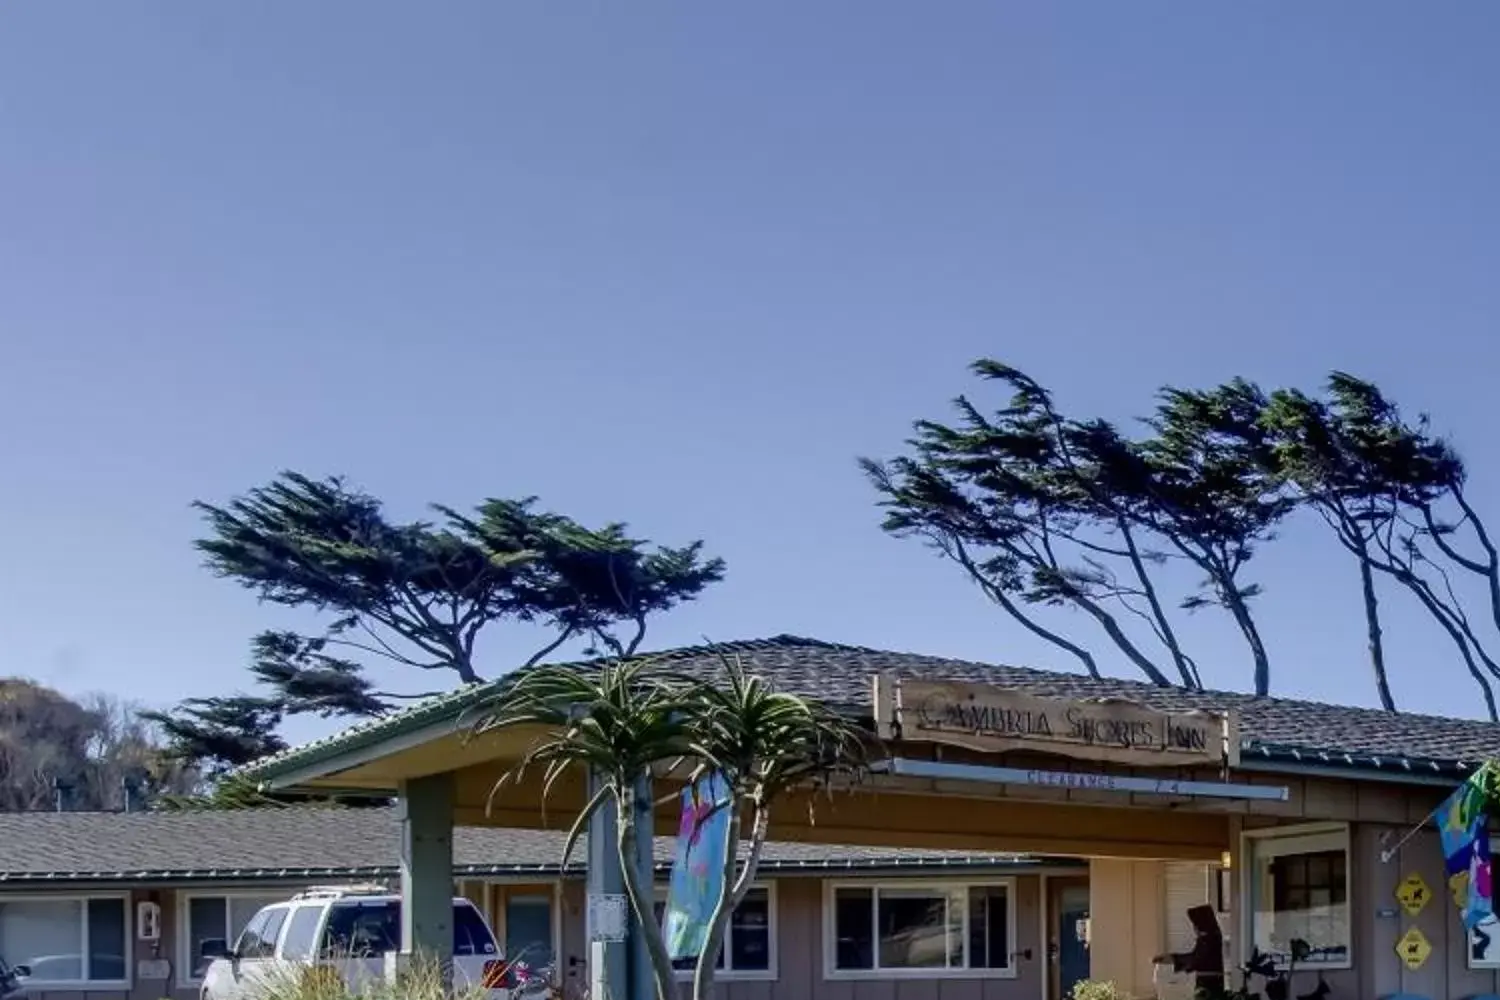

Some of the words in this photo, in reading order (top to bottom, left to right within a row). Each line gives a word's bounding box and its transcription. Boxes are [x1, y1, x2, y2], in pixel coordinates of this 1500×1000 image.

[1066, 706, 1152, 746] SHORES
[1162, 715, 1206, 749] INN
[1027, 769, 1116, 789] CLEARANCE
